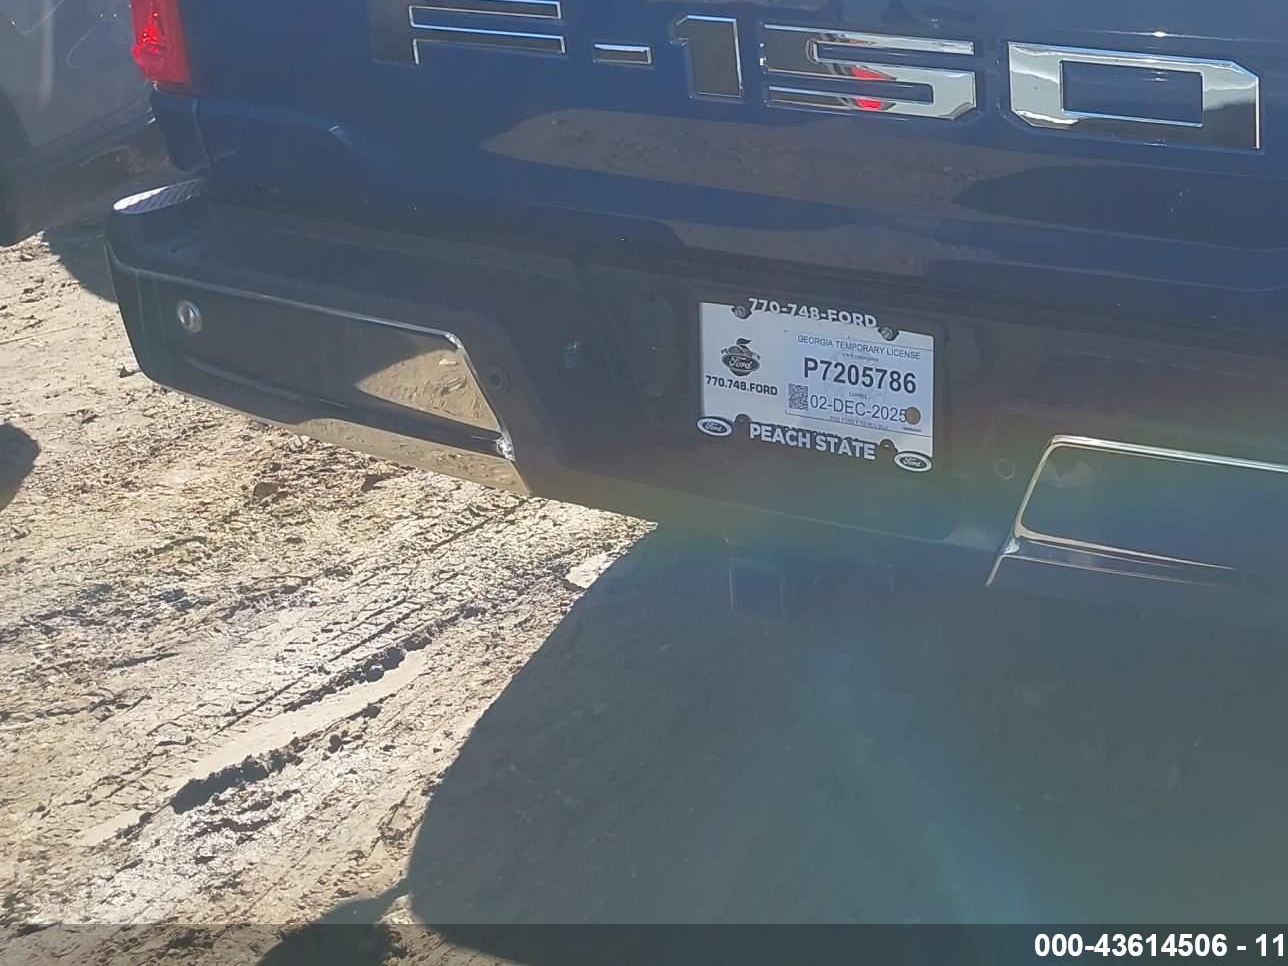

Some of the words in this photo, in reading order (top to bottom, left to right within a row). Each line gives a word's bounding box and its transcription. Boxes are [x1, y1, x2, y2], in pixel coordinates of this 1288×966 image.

[748, 297, 878, 329] 770-748-FORD
[797, 334, 833, 347] GEORGIA
[836, 340, 885, 354] TEMPORARY
[886, 347, 921, 360] LICENSE
[728, 355, 753, 370] Ford
[803, 356, 916, 394] P7205786
[705, 375, 778, 396] 770.748.FORD
[810, 394, 907, 423] 02-DEC-2025
[750, 422, 811, 450] PEACH
[815, 435, 876, 461] STATE
